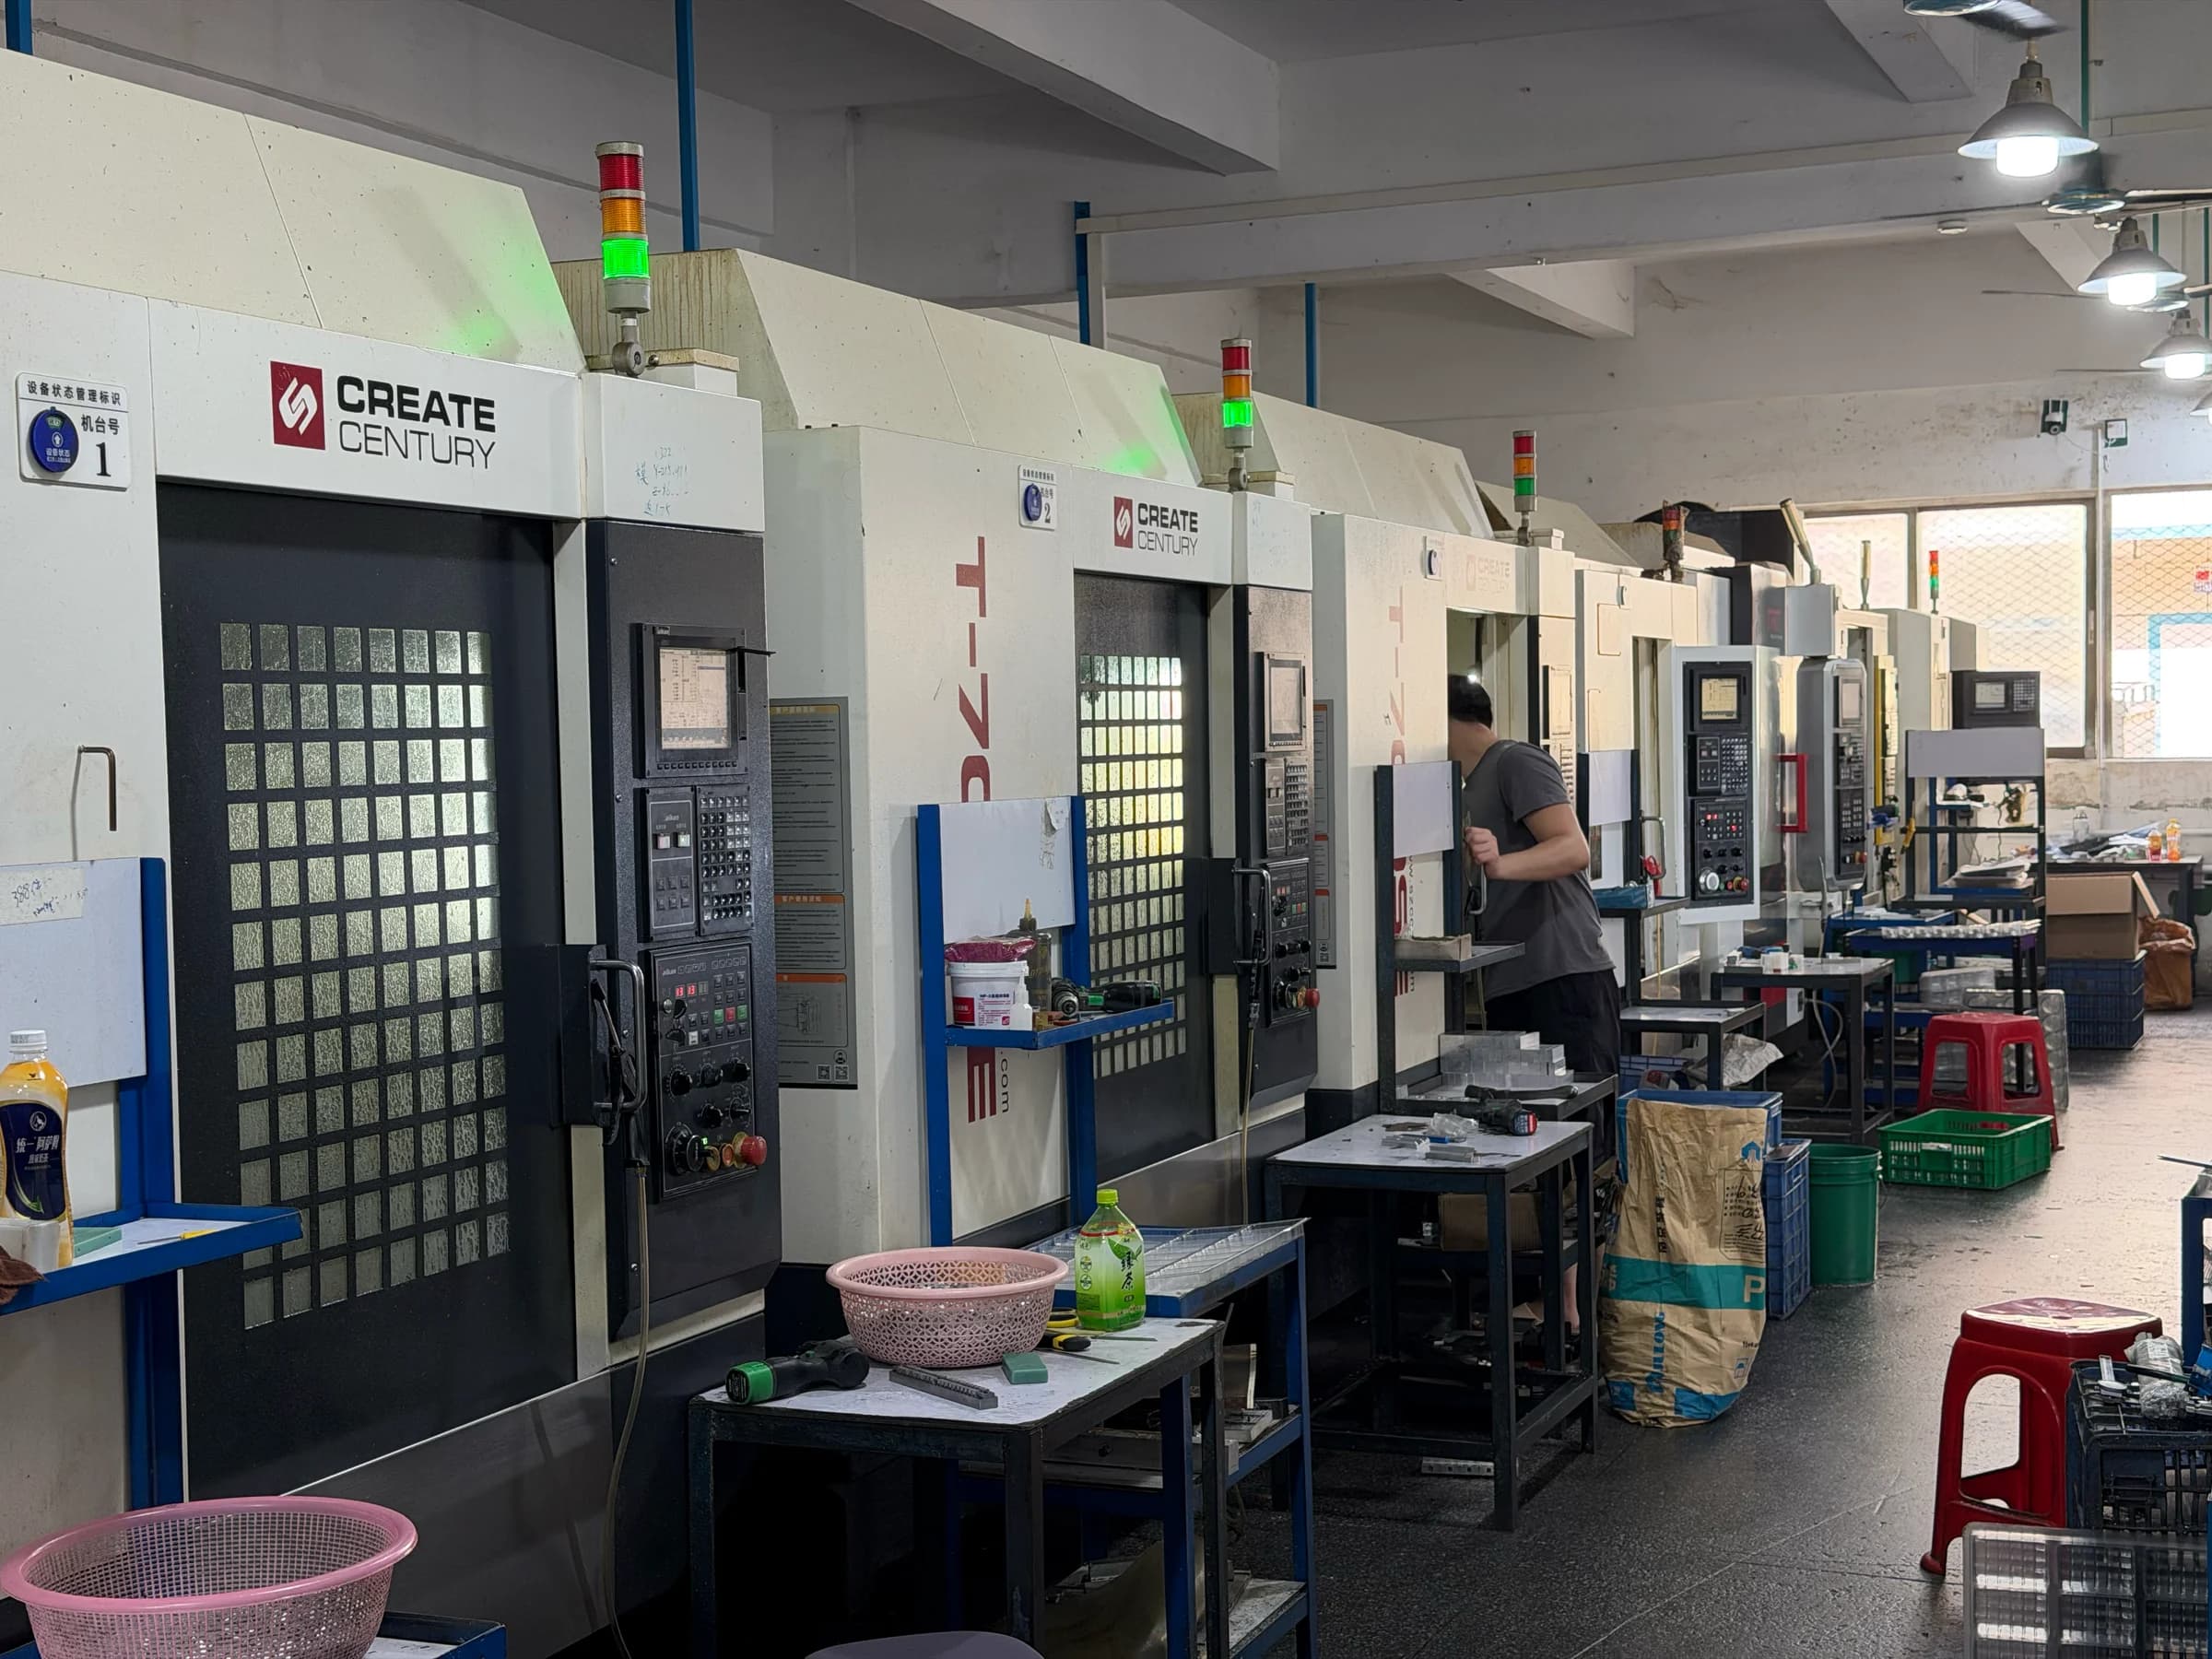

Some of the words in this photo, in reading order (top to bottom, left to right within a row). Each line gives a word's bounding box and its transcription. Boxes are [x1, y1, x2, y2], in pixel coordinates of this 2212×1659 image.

[27, 381, 122, 406] 设备状态管理标识
[337, 375, 496, 433] CREATE
[81, 414, 120, 435] 机台号
[339, 420, 496, 469] CENTURY
[96, 441, 112, 477] 1
[1044, 502, 1051, 524] 2
[1137, 502, 1199, 533] CREATE
[1137, 530, 1199, 556] CENTURY
